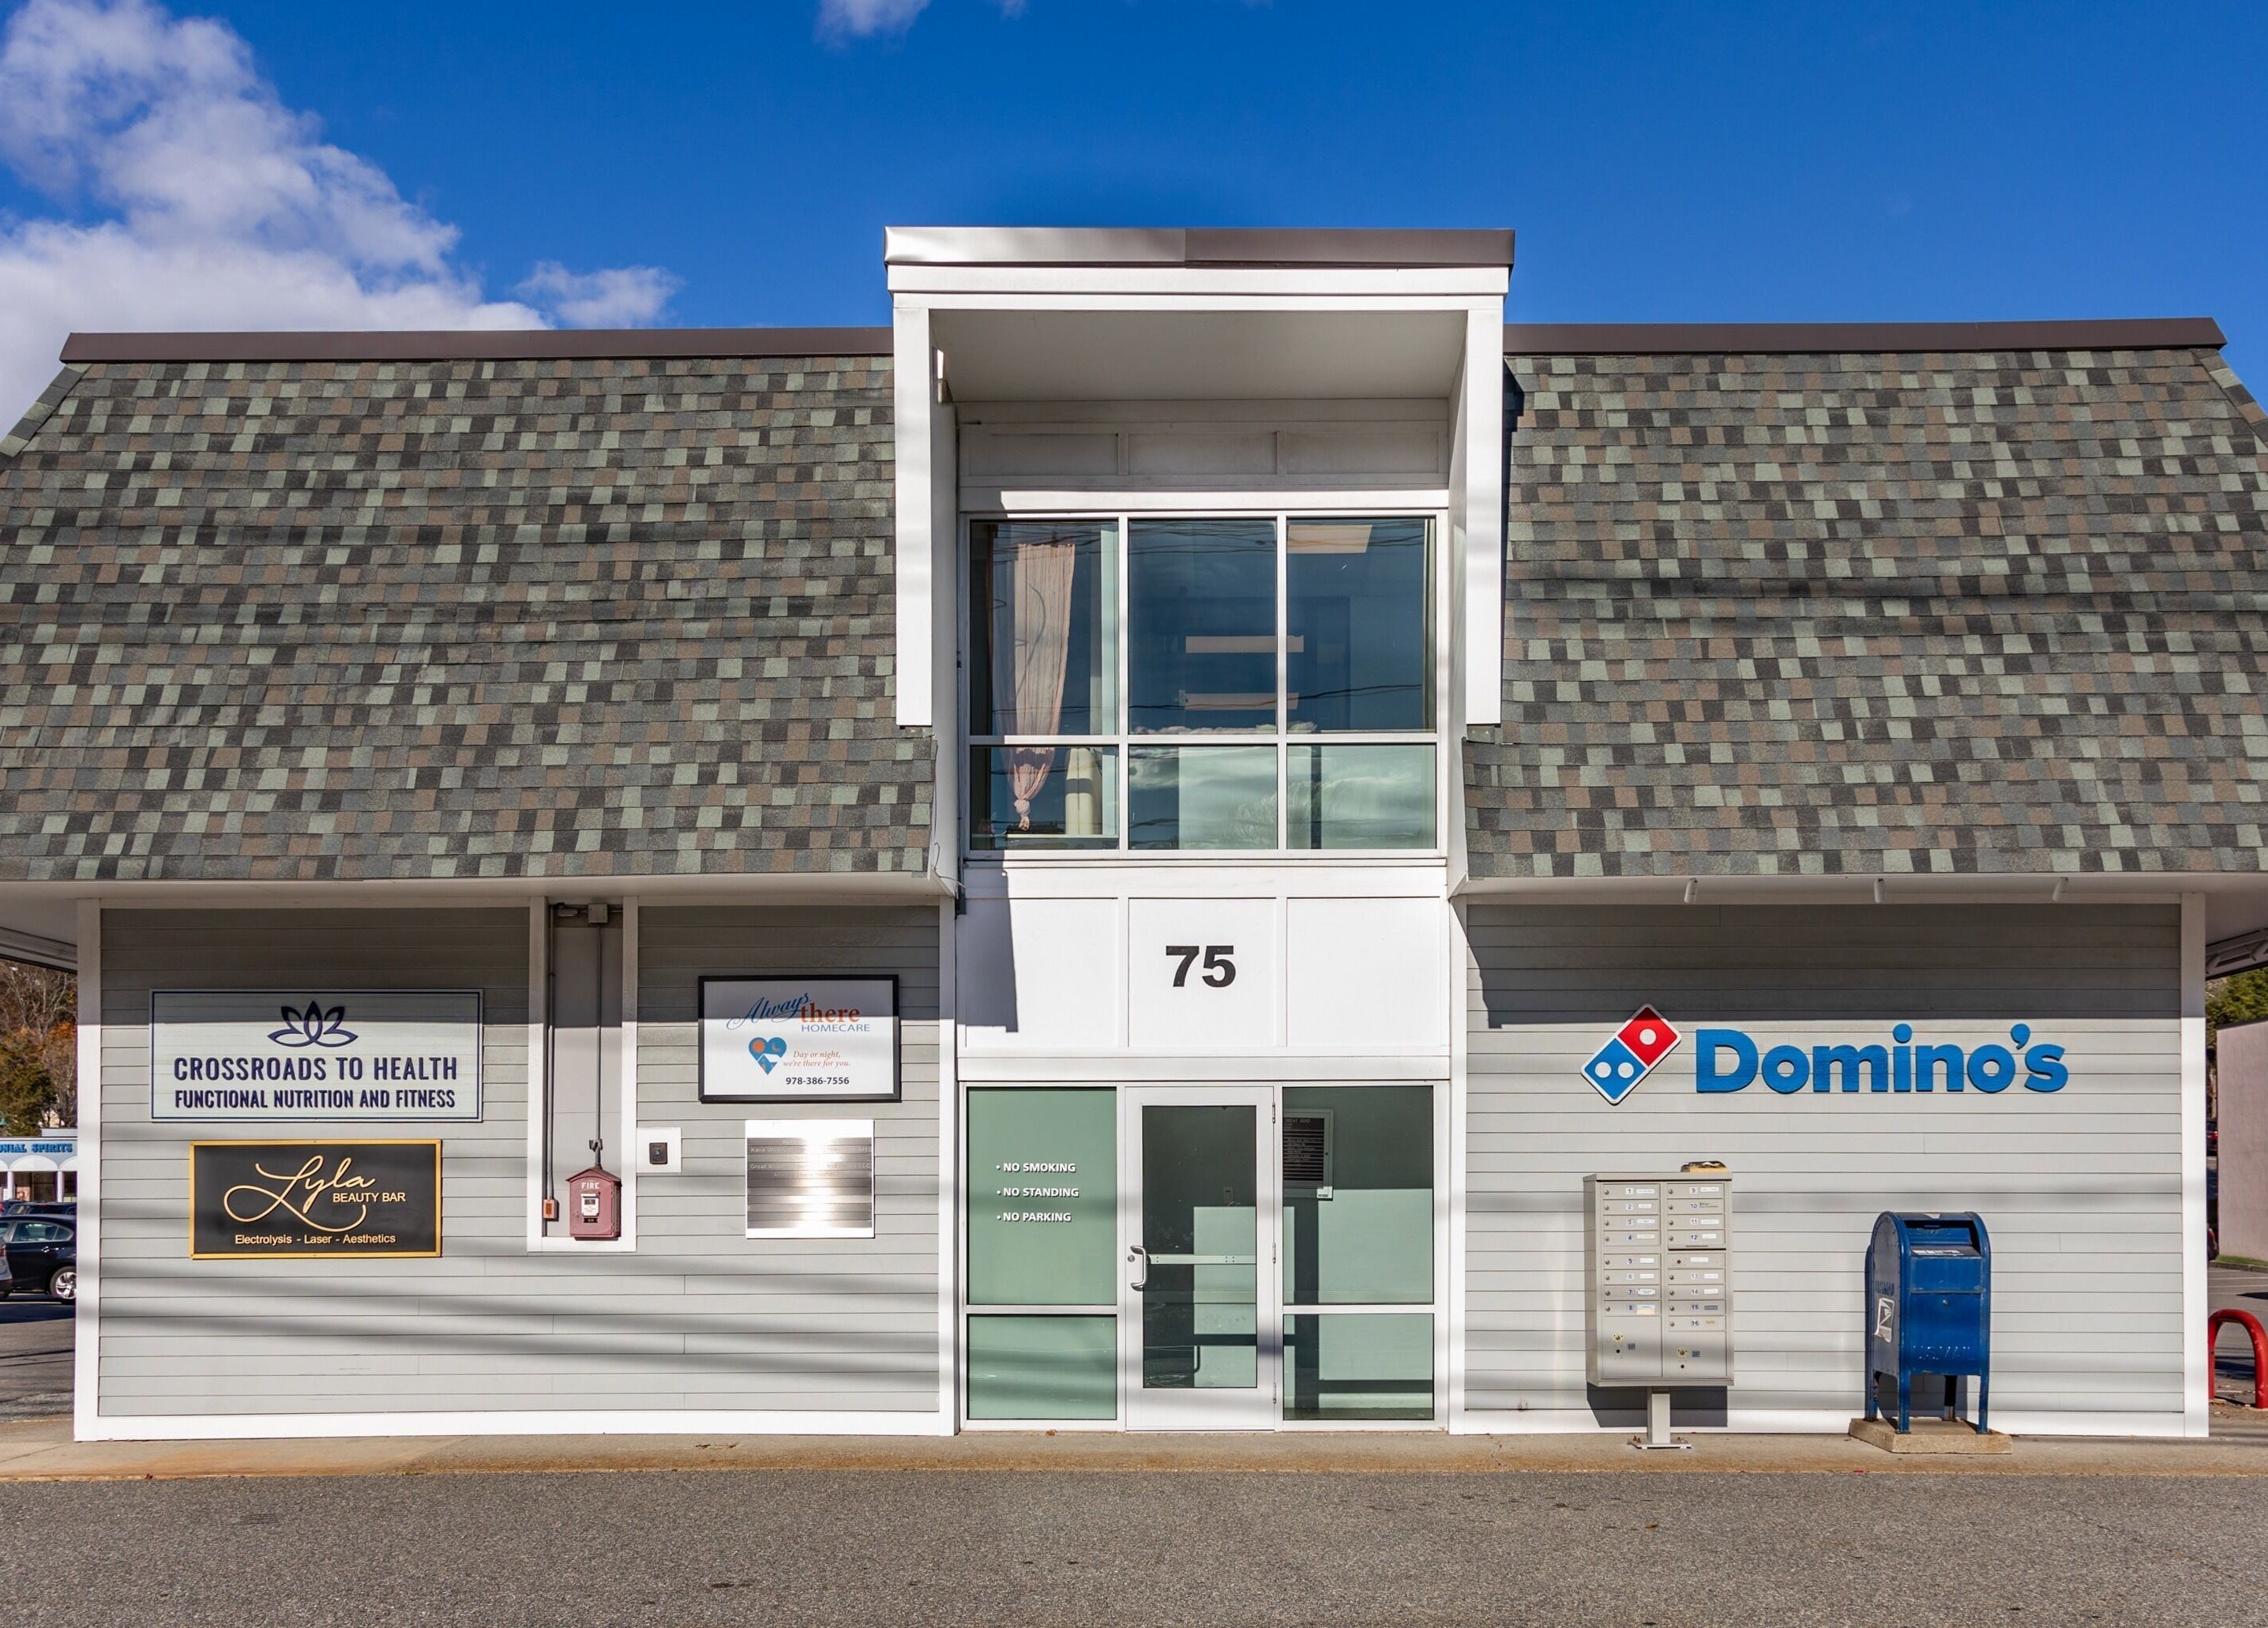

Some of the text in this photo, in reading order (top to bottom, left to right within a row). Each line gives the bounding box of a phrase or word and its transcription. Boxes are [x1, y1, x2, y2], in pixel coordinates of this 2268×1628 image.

[1166, 946, 1236, 987] 75
[727, 992, 861, 1030] Always there
[801, 1024, 870, 1032] HOMECARE
[793, 1051, 808, 1059] Day
[819, 1051, 841, 1059] night,
[1696, 1023, 2069, 1094] Domino's
[822, 1059, 833, 1068] for
[174, 1057, 457, 1081] CROSSROADS TO HEALTH
[786, 1077, 850, 1085] 978-386-7556
[175, 1089, 456, 1108] FUNCTIONAL NUTRITION AND FITNESS
[32, 1144, 73, 1152] SPIRITS
[1003, 1163, 1076, 1172] NO SMOKING
[223, 1155, 376, 1232] Lyla
[332, 1192, 407, 1203] BEAUTY BAR
[1003, 1188, 1080, 1198] NO STANDING
[1003, 1213, 1072, 1222] NO PARKING
[235, 1235, 292, 1246] Electrolysis
[304, 1235, 332, 1244] Laser
[343, 1234, 396, 1244] Aesthetics
